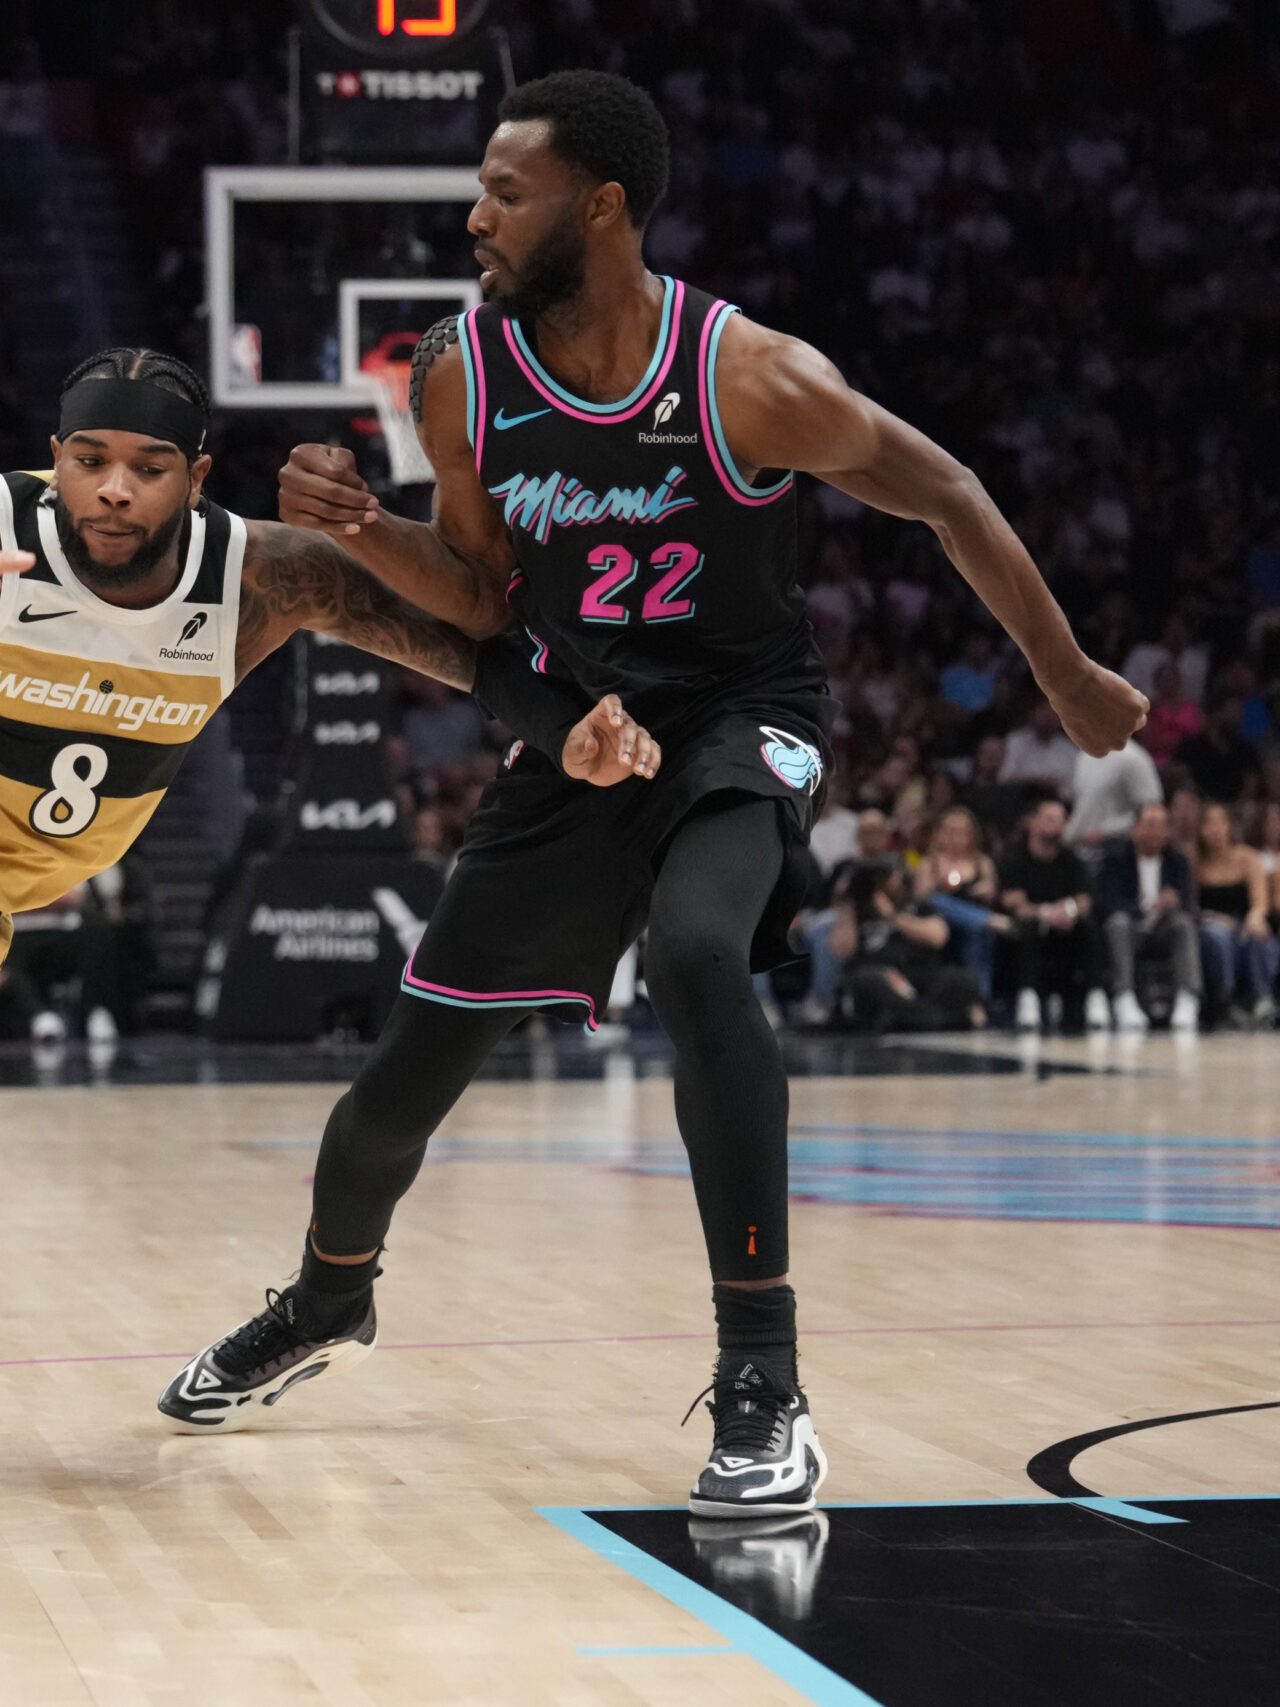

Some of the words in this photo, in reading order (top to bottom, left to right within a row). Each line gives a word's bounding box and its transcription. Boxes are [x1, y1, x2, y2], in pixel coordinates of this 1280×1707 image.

[638, 432, 698, 444] Robinhood
[488, 465, 699, 545] Miami
[579, 542, 705, 625] 22
[158, 647, 215, 663] Robinhood
[29, 742, 109, 839] 8
[250, 904, 380, 935] American
[275, 934, 380, 962] Airlines
